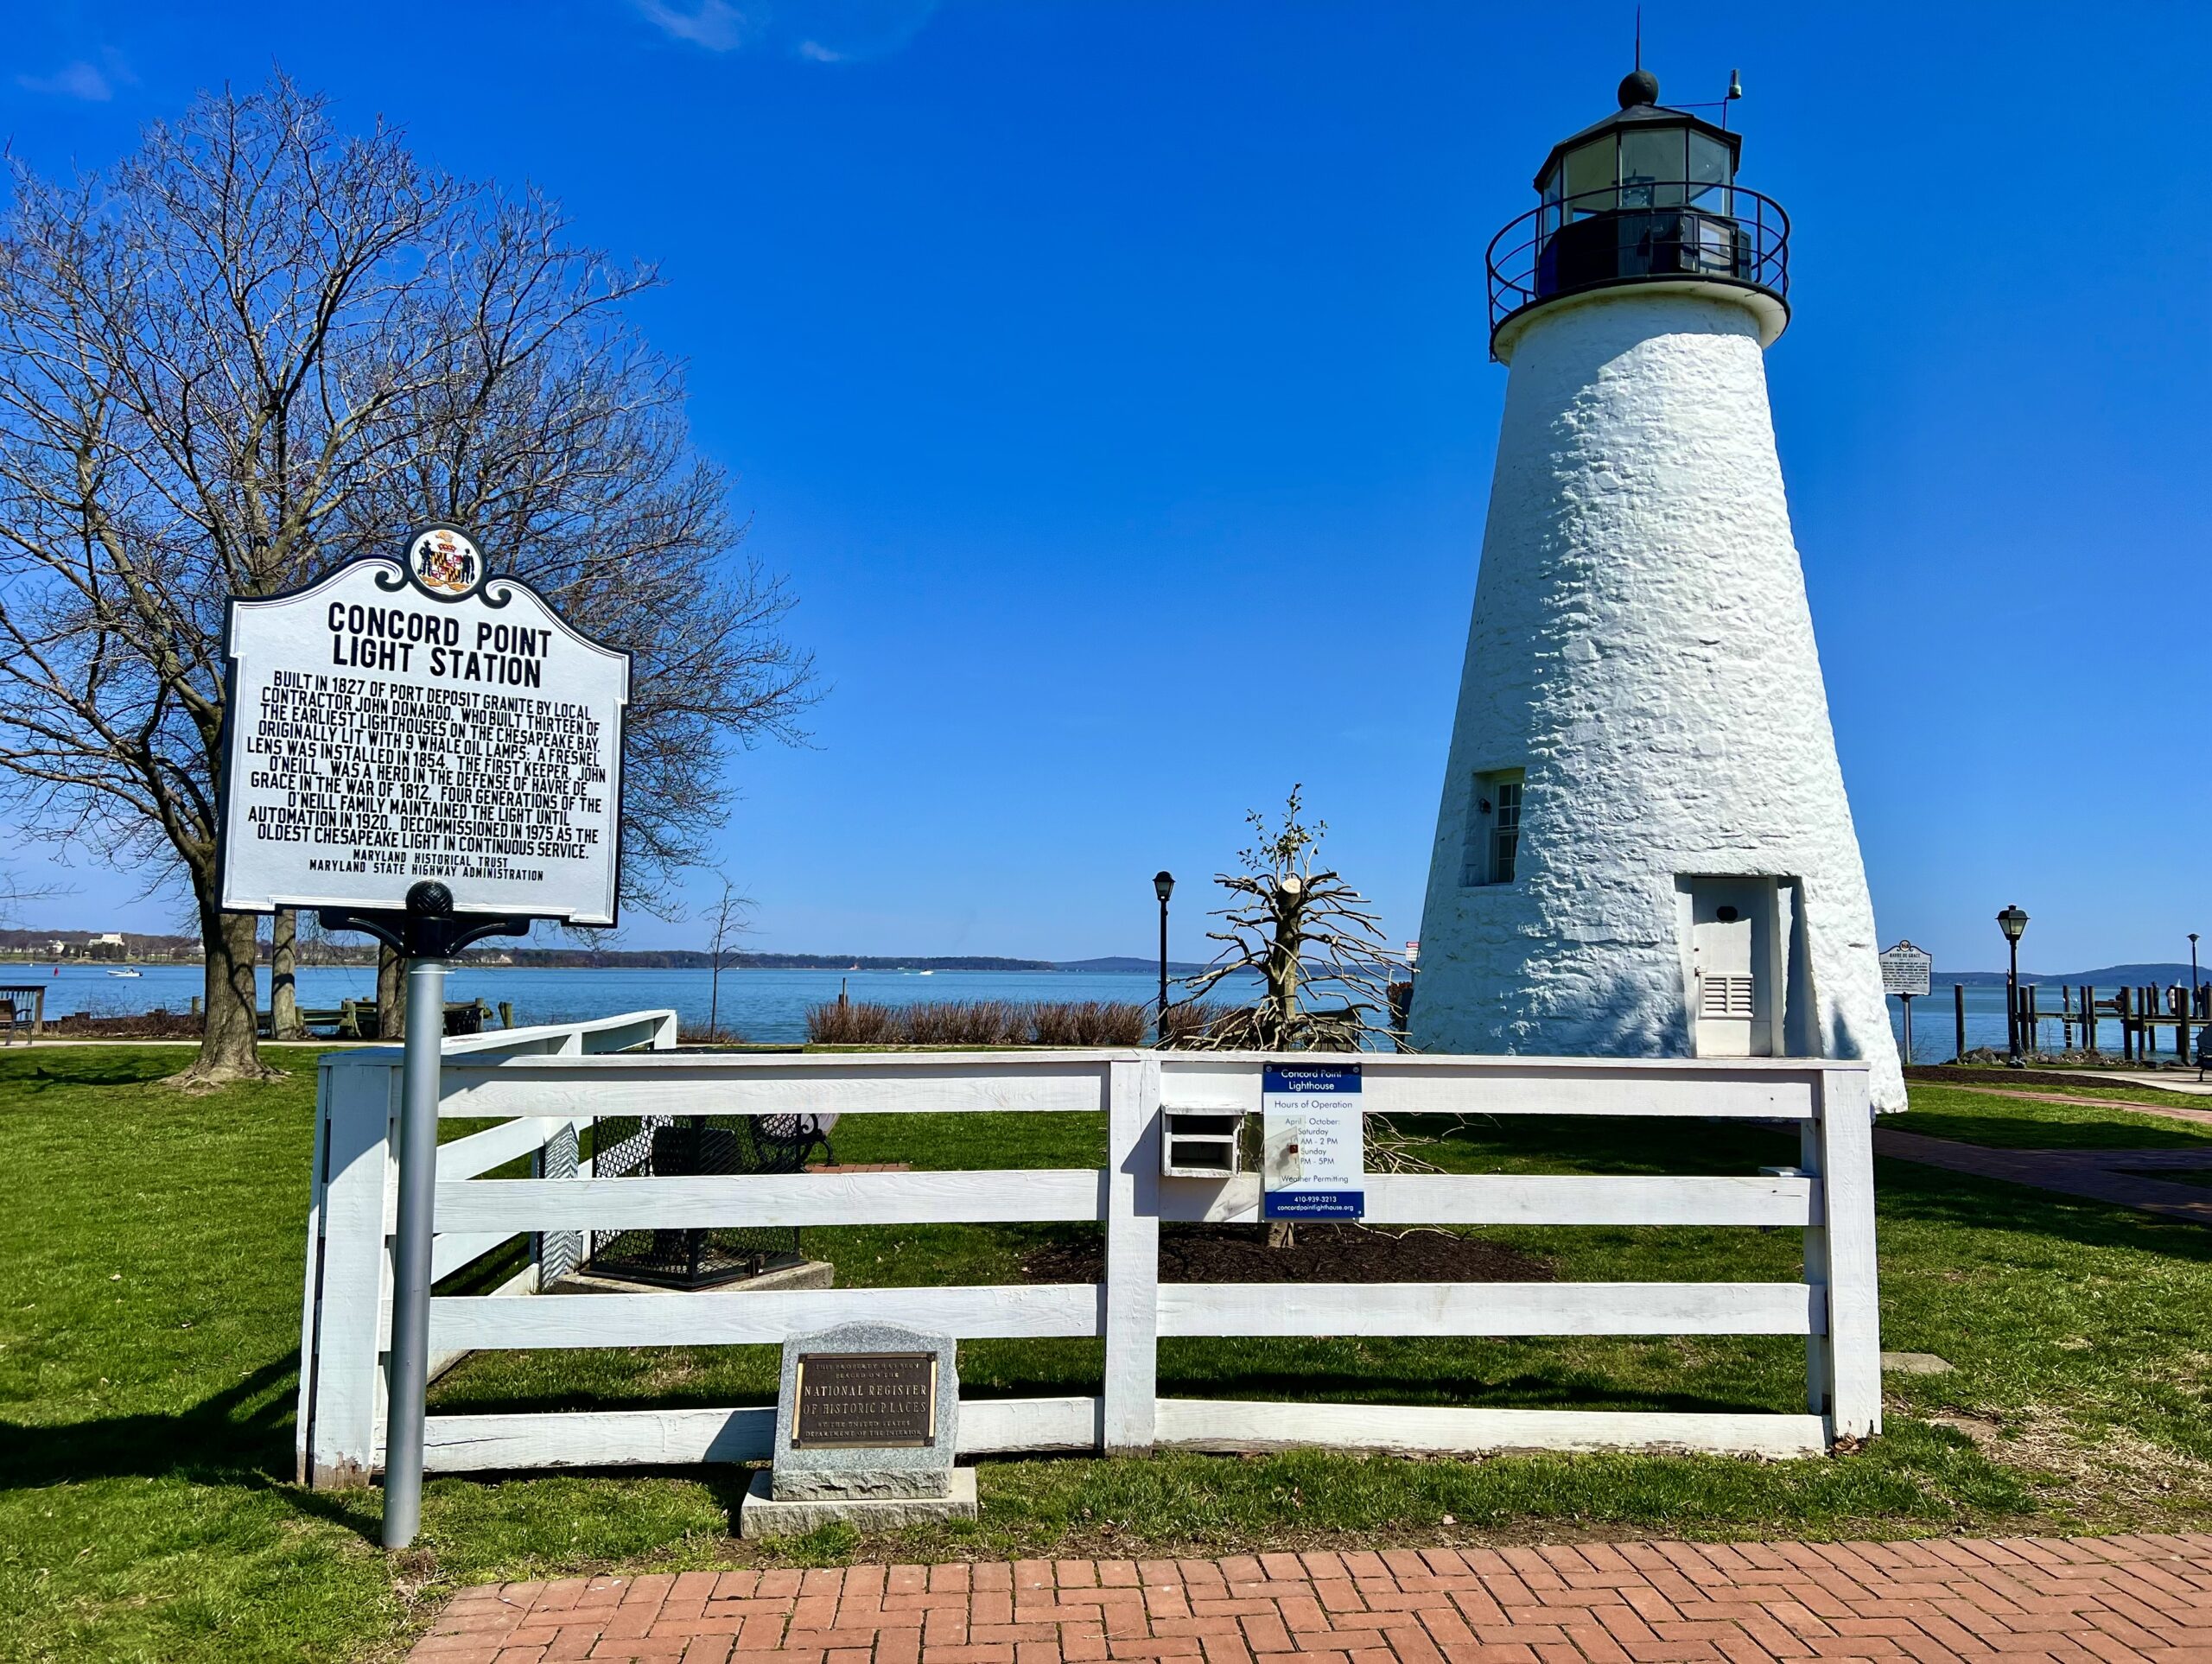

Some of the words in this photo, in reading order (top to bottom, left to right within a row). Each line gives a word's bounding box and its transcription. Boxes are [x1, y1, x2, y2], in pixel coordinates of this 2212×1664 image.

[328, 601, 460, 646] CONCORD
[476, 622, 552, 657] POINT
[333, 634, 414, 672] LIGHT
[429, 646, 541, 689] STATION
[262, 686, 352, 711] CONTRACTOR
[355, 696, 388, 715] JOHN
[461, 708, 486, 725] WHO
[489, 710, 523, 728] BUILT
[526, 715, 583, 735] THIRTEEN
[587, 721, 600, 737] OF
[274, 670, 313, 689] BUILT
[315, 675, 327, 692] IN
[332, 676, 365, 695] 1827
[370, 681, 386, 698] OF
[390, 683, 424, 702] PORT
[427, 687, 480, 708] DEPOSIT
[483, 694, 533, 715] GRANITE
[537, 700, 551, 716] BY
[555, 702, 591, 721] LOCAL
[258, 720, 338, 743] ORIGINALLY
[341, 727, 364, 745] LIT
[368, 730, 402, 749] WITH
[405, 734, 414, 750] 9
[417, 735, 461, 754] WHALE
[464, 740, 483, 757] OIL
[537, 746, 545, 762] A
[549, 748, 600, 767] FRESNEL
[260, 702, 288, 721] THE
[292, 706, 357, 727] EARLIEST
[359, 713, 447, 737] LIGHTHOUSES
[450, 722, 466, 739] ON
[470, 724, 494, 742] THE
[497, 727, 574, 750] CHESAPEAKE
[247, 736, 283, 755] LENS
[287, 740, 316, 758] WAS
[321, 743, 394, 765] INSTALLED
[397, 750, 410, 766] IN
[456, 755, 481, 772] THE
[485, 758, 520, 776] FIRST
[577, 766, 606, 783] JOHN
[251, 771, 296, 791] GRACE
[299, 775, 312, 791] IN
[315, 776, 342, 794] THE
[346, 778, 375, 797] WAR
[378, 781, 395, 797] OF
[441, 785, 473, 803] FOUR
[475, 789, 557, 810] GENERATIONS
[561, 795, 576, 811] OF
[579, 797, 601, 813] THE
[330, 760, 359, 778] WAS
[362, 763, 372, 779] A
[377, 764, 410, 783] HERO
[413, 767, 425, 784] IN
[429, 768, 454, 786] THE
[456, 771, 511, 791] DEFENSE
[513, 776, 529, 791] OF
[531, 778, 569, 795] HAVRE
[573, 781, 588, 797] DE
[248, 805, 337, 827] AUTOMATION
[340, 811, 353, 829] IN
[400, 816, 508, 838] DECOMMISSIONED
[511, 823, 522, 839] IN
[525, 824, 554, 842] 1975
[556, 827, 572, 842] AS
[575, 828, 599, 844] THE
[288, 791, 336, 810] O'NEILL
[340, 795, 385, 814] FAMILY
[390, 798, 467, 819] MAINTAINED
[471, 804, 495, 822] THE
[499, 806, 533, 823] LIGHT
[537, 809, 570, 827] UNTIL
[257, 822, 311, 842] OLDEST
[315, 827, 399, 848] CHESAPEAKE
[402, 832, 441, 850] LIGHT
[443, 835, 455, 851] IN
[459, 836, 534, 856] CONTINUOUS
[537, 842, 589, 860] SERVICE.
[353, 848, 406, 863] MARYLAND
[414, 852, 472, 867] HISTORICAL
[478, 856, 508, 868] TRUST
[309, 859, 365, 873] MARYLAND
[373, 862, 405, 875] STATE
[411, 864, 457, 877] HIGHWAY
[462, 867, 543, 881] ADMINISTRATION
[1281, 1070, 1319, 1078] Concord
[1320, 1070, 1342, 1078] Point
[1288, 1082, 1335, 1091] Lighthouse
[1285, 1118, 1302, 1127] April
[1311, 1101, 1353, 1109] Operation
[1313, 1175, 1349, 1184] Permitting
[803, 1404, 818, 1415] OF
[823, 1402, 876, 1415] HISTORIC
[880, 1401, 927, 1413] PLACES
[804, 1385, 864, 1397] NATIONAL
[868, 1384, 927, 1396] REGISTER
